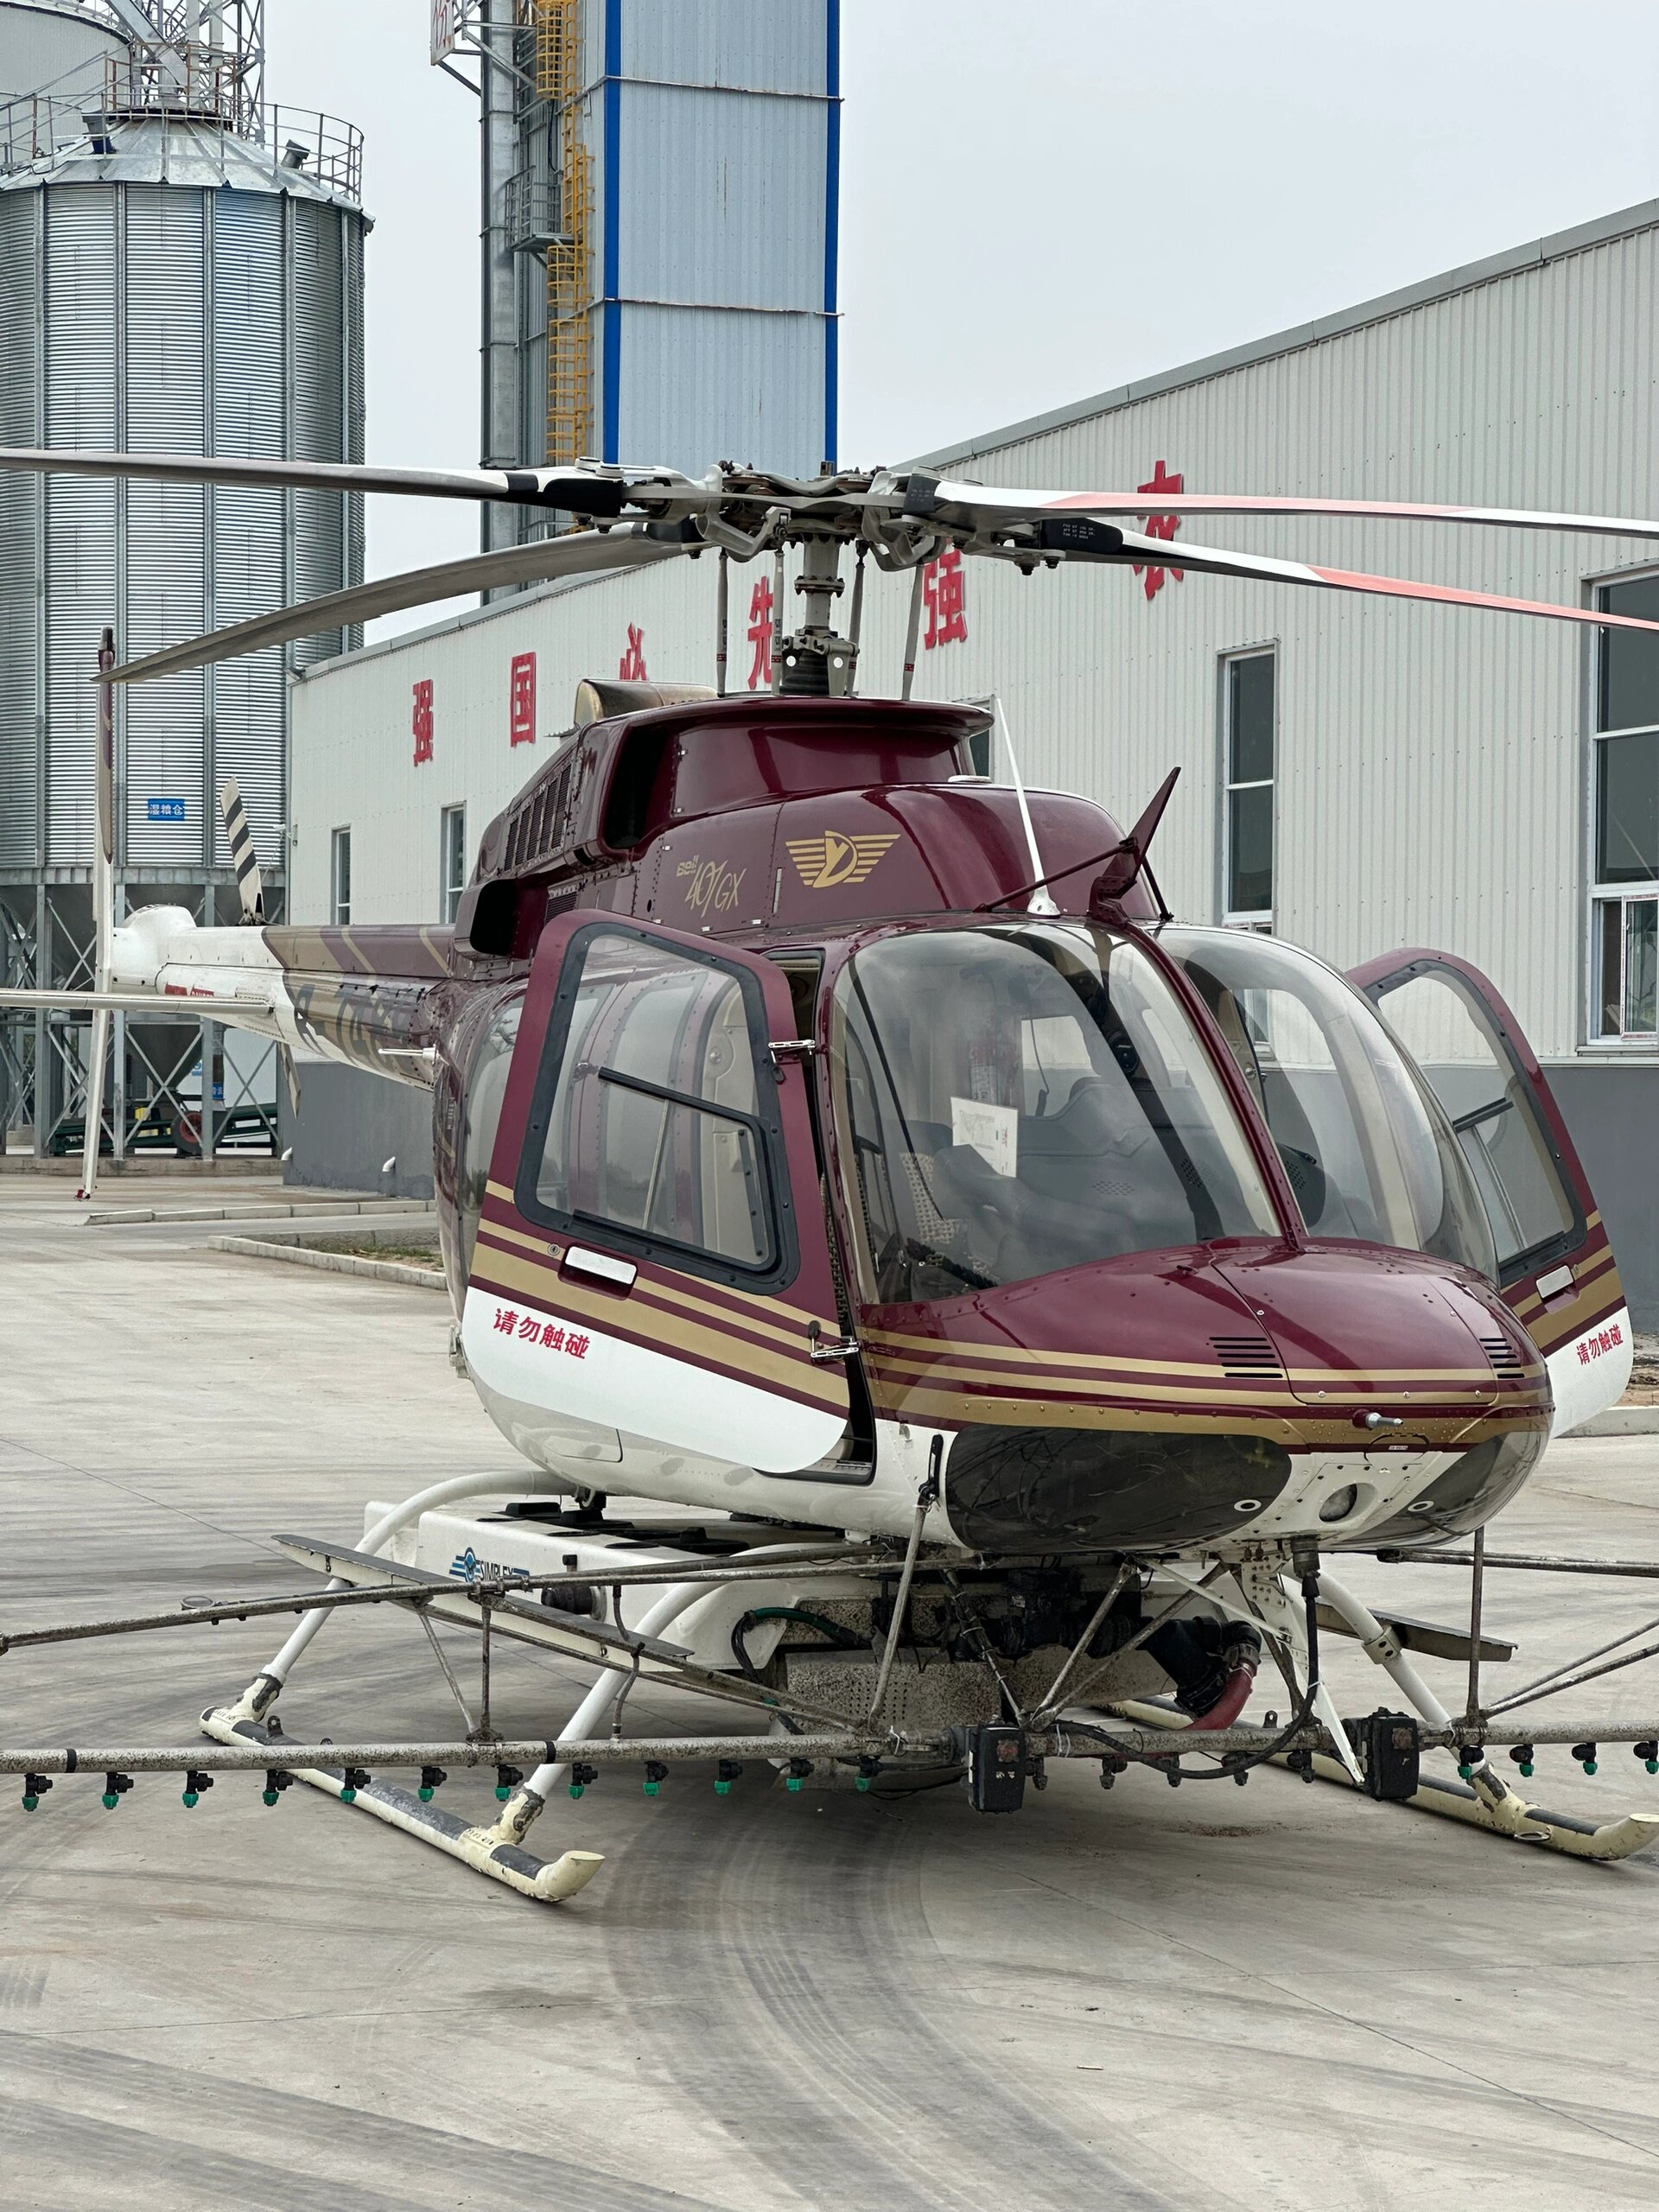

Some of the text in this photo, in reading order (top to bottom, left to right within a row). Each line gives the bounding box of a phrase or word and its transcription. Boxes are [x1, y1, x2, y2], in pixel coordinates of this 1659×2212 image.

[493, 1307, 591, 1359] 请勿触碰
[1576, 1323, 1624, 1366] 请勿触碰
